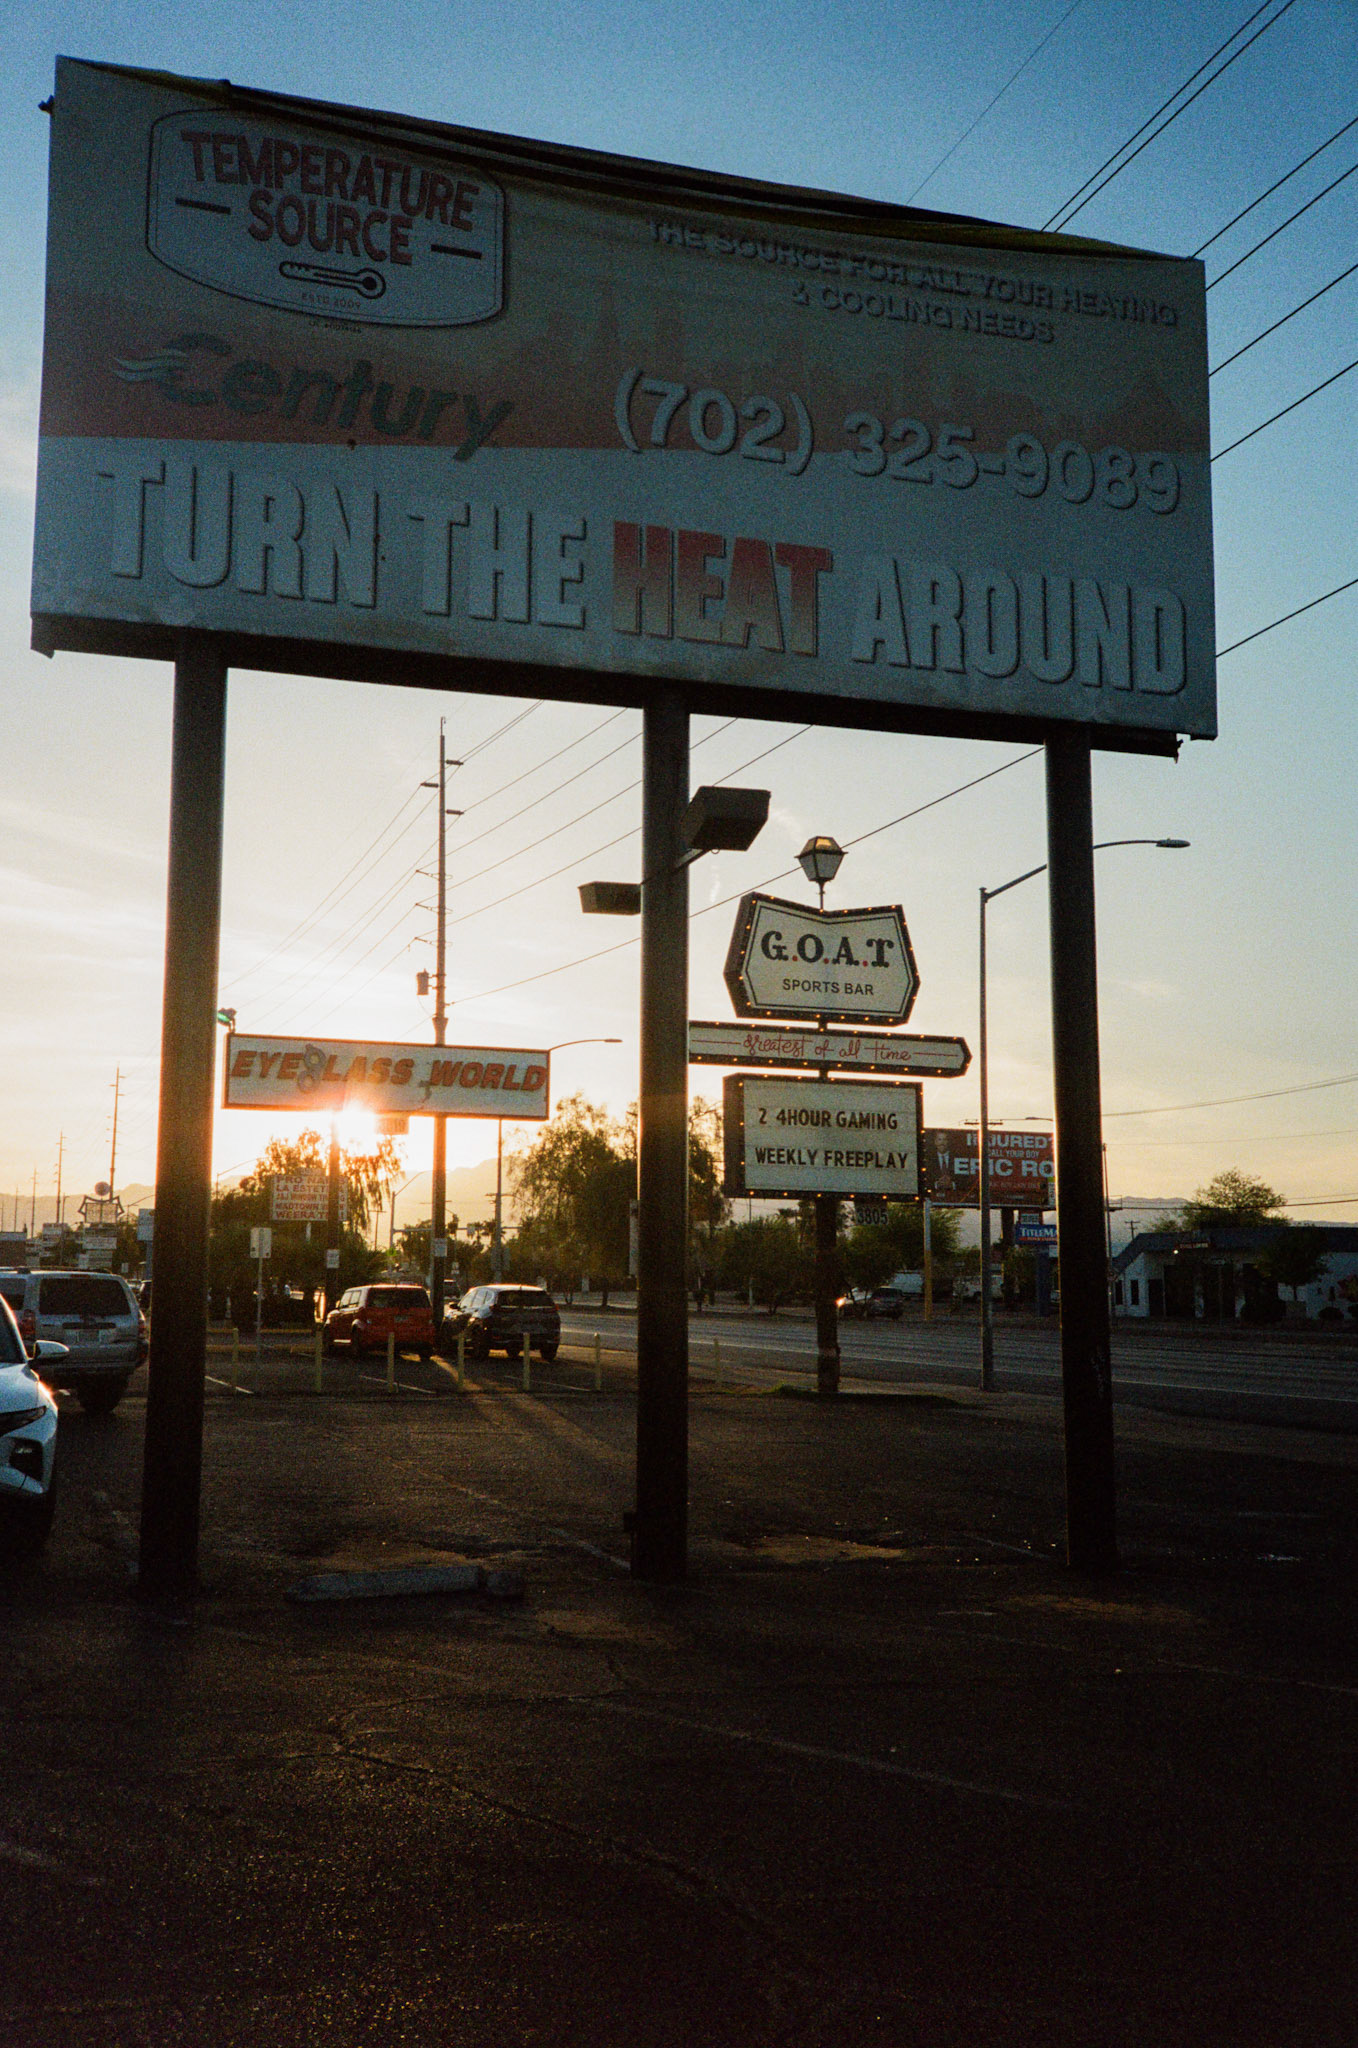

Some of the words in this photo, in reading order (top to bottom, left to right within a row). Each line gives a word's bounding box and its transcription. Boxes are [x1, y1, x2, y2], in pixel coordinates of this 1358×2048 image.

[181, 130, 479, 232] TEMPERATURE
[248, 189, 413, 266] SOURCE
[650, 220, 706, 250] THE
[717, 233, 839, 274] SOURCE
[848, 252, 907, 285] FOR
[917, 263, 971, 295] ALL
[981, 272, 1054, 309] YOUR
[1063, 286, 1179, 327] HEATING
[821, 285, 953, 330] COOLING
[964, 307, 1054, 344] NEEDS
[153, 333, 514, 461] Century
[613, 367, 816, 476] (702)
[843, 411, 1182, 516] 325-9089
[97, 460, 380, 608] TURN
[409, 502, 587, 631] THE
[612, 520, 834, 658] HEAT
[853, 558, 1188, 696] AROUND
[761, 930, 894, 969] G.O.A.T
[782, 978, 840, 995] SPORTS
[845, 982, 875, 997] BAR
[815, 1038, 834, 1059] of
[839, 1040, 861, 1060] all
[864, 1038, 912, 1061] time
[430, 1059, 547, 1092] WORLD
[776, 1108, 832, 1128] 4HOUR
[836, 1110, 898, 1130] GAMING
[755, 1147, 817, 1166] WEEKLY
[823, 1149, 909, 1170] FREEPLAY
[1006, 1149, 1025, 1158] YOUR
[1026, 1150, 1040, 1159] BOY
[276, 1176, 304, 1184] PRO
[857, 1206, 888, 1225] 3805
